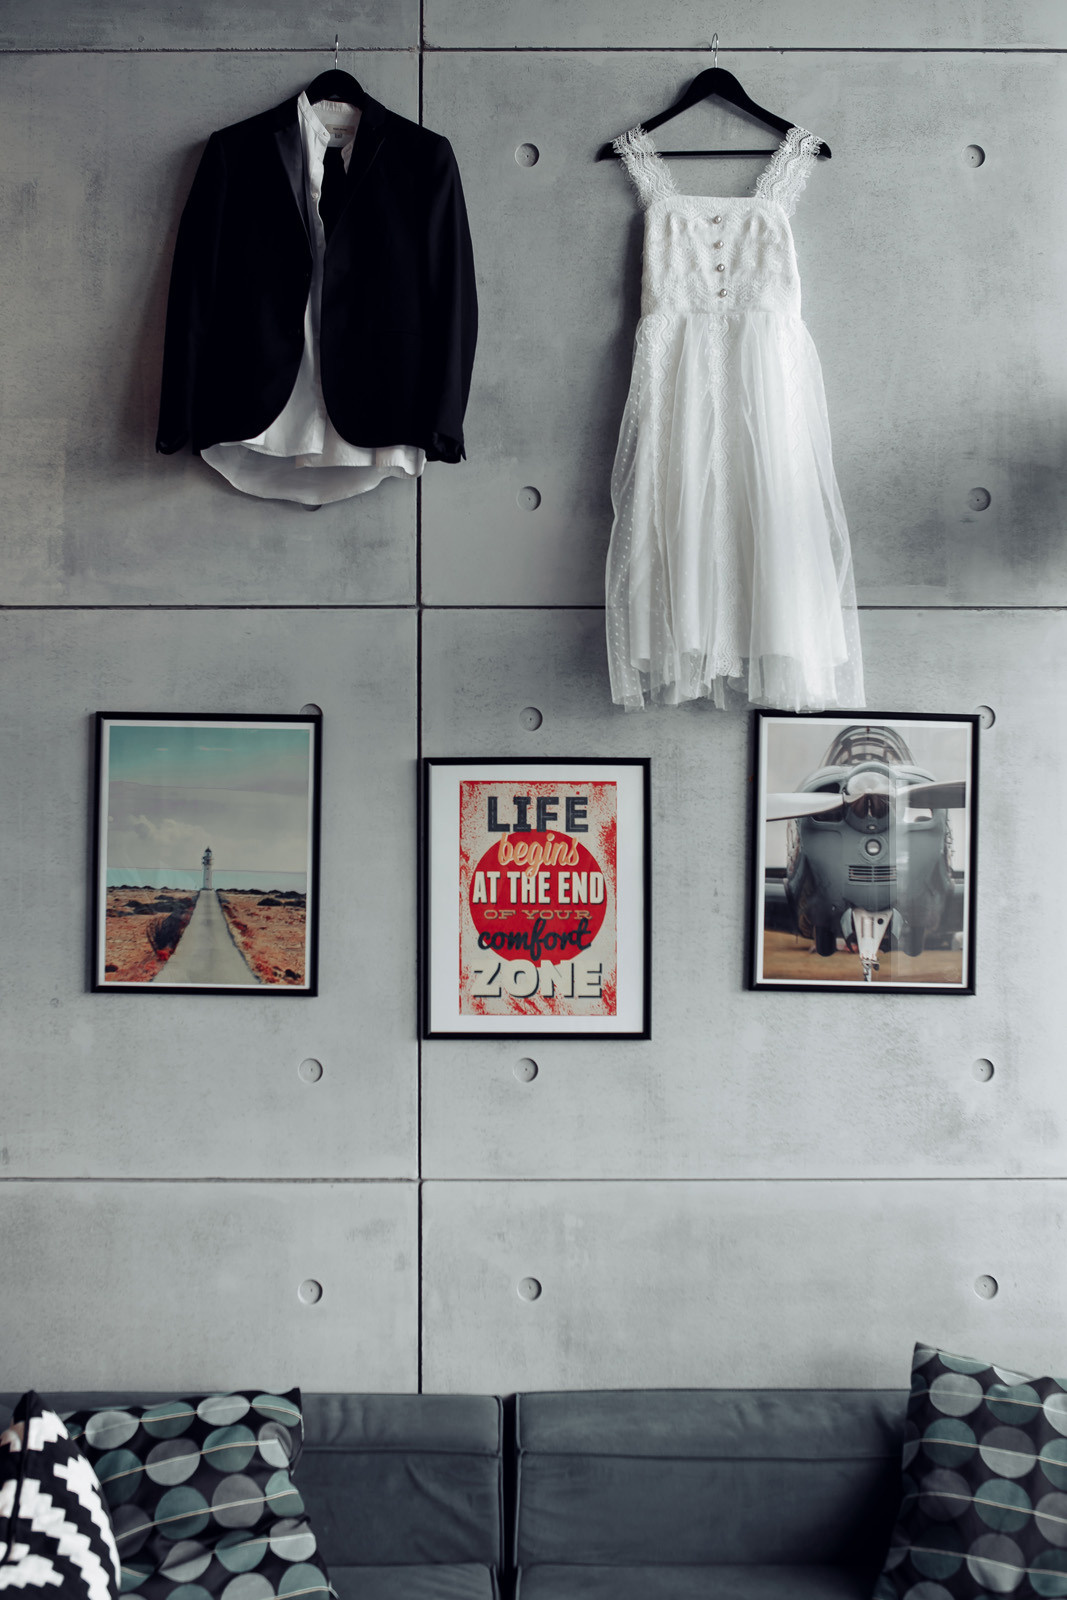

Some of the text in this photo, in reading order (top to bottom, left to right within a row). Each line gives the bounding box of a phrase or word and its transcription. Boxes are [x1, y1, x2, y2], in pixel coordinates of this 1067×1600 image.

[487, 796, 589, 832] LIFE
[498, 832, 579, 877] begins
[472, 871, 604, 904] AT THE END
[483, 909, 593, 920] OF YOUR
[477, 917, 592, 961] comfort
[471, 959, 602, 998] ZONE
